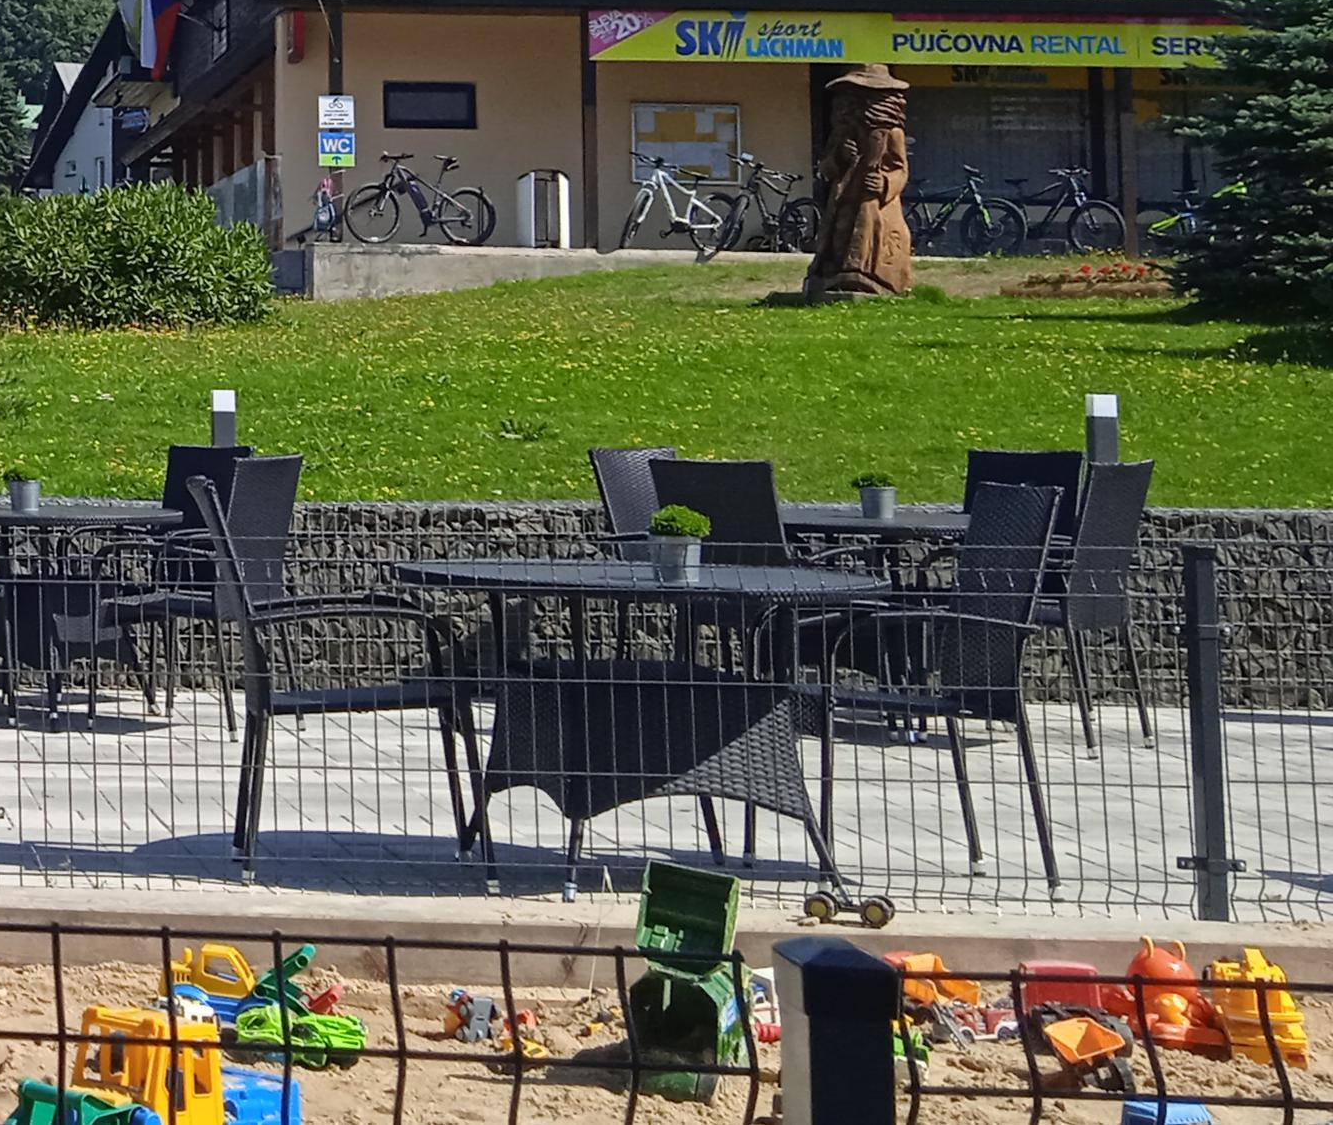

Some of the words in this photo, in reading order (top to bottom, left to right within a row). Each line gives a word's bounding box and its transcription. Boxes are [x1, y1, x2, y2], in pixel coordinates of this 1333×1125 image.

[758, 20, 822, 40] sport
[746, 38, 844, 58] LACHMAN
[892, 28, 1024, 53] PŮJČOVNA
[1030, 35, 1126, 55] RENTAL
[323, 138, 351, 153] WC
